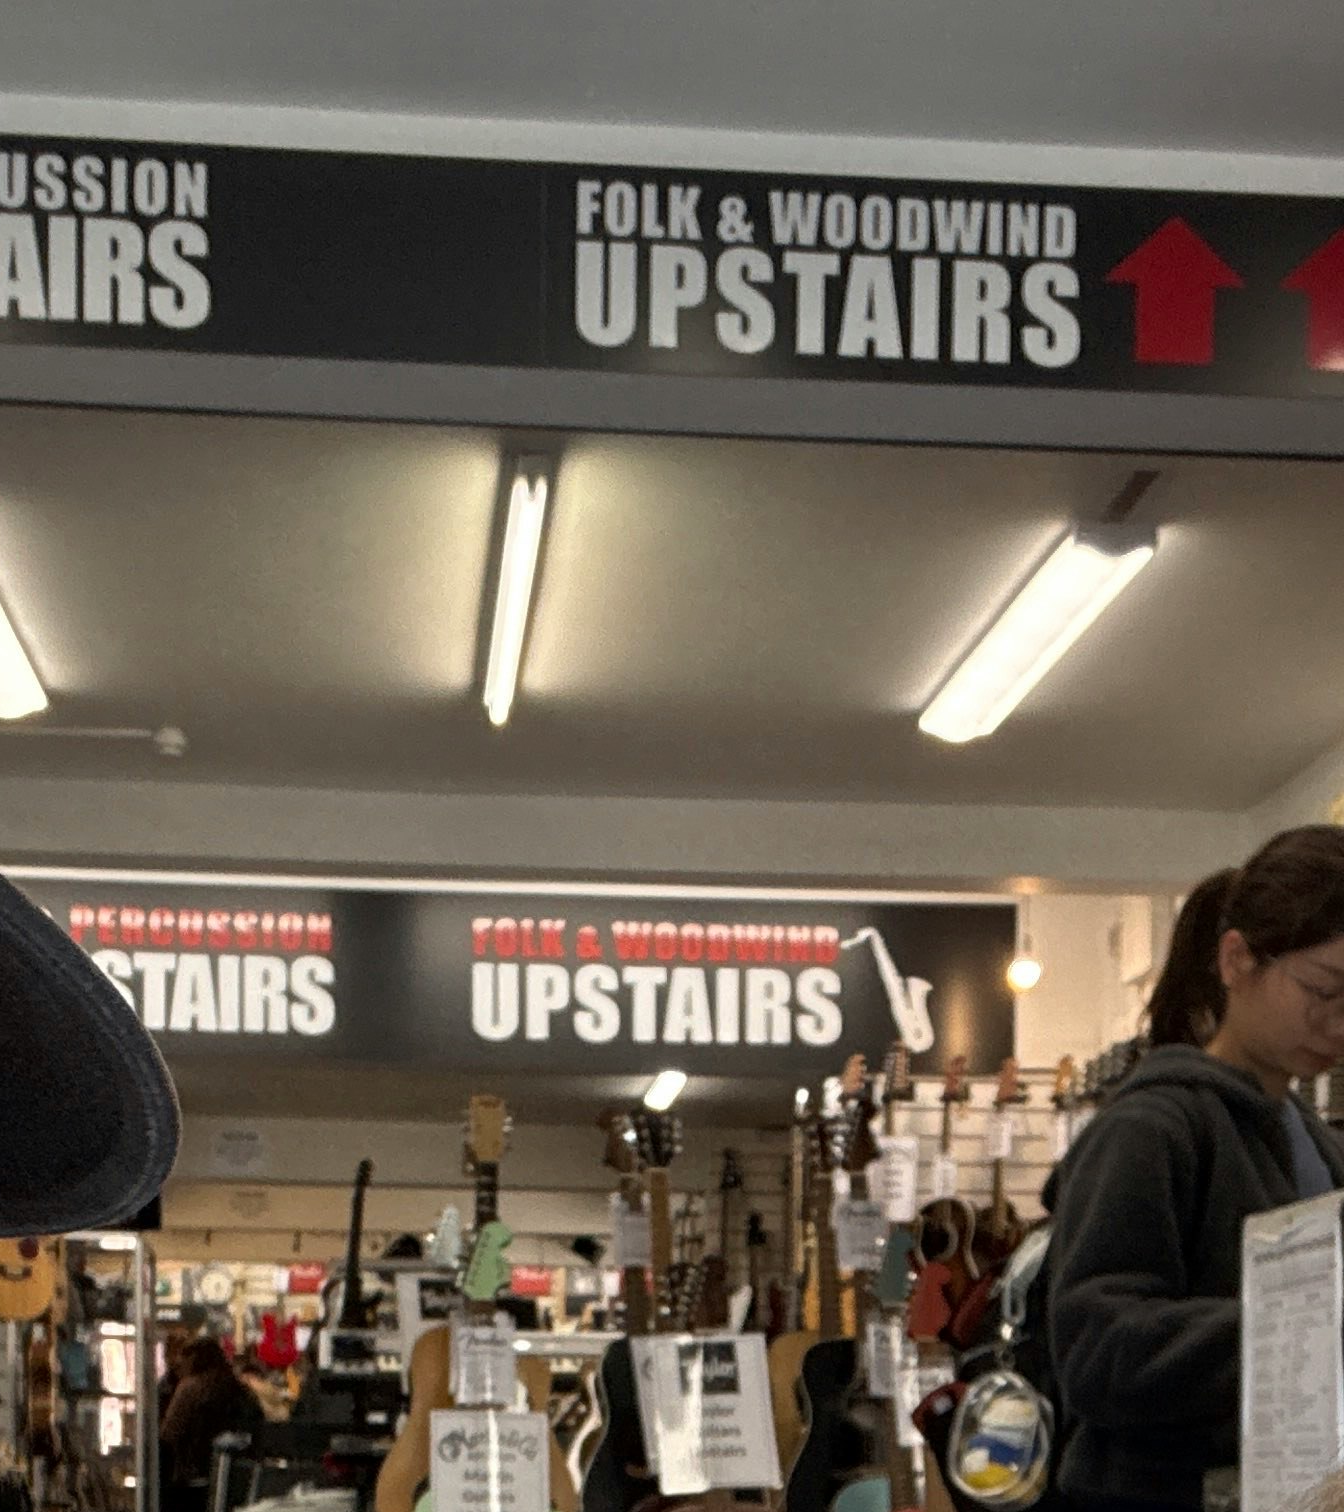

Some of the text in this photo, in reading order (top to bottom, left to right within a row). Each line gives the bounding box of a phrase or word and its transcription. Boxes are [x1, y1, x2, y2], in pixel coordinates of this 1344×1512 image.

[576, 180, 1077, 258] FOLK & WOODWIND
[575, 240, 1081, 368] UPSTAIRS
[69, 904, 333, 952] PERCUSSION
[471, 917, 839, 962] FOLK & WOODWIND
[92, 950, 336, 1034] STAIRS
[471, 962, 842, 1044] UPSTAIRS
